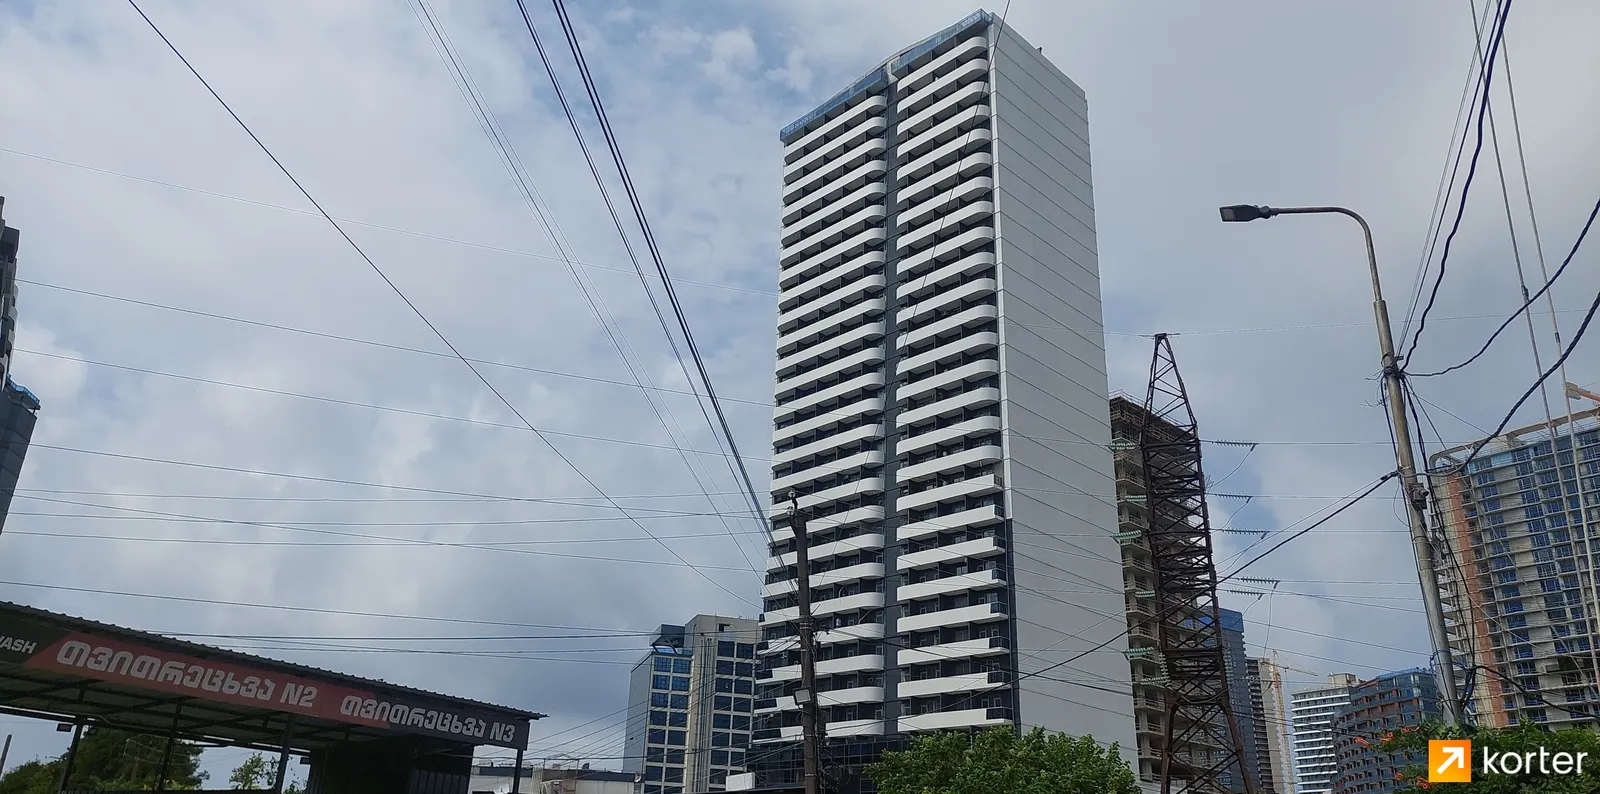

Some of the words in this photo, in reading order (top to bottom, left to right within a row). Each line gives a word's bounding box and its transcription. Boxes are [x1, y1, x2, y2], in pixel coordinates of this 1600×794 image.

[56, 640, 276, 701] თვითრეცხვა
[279, 682, 318, 708] N2
[340, 695, 487, 738] თვითრეცხვა
[489, 722, 516, 743] N3
